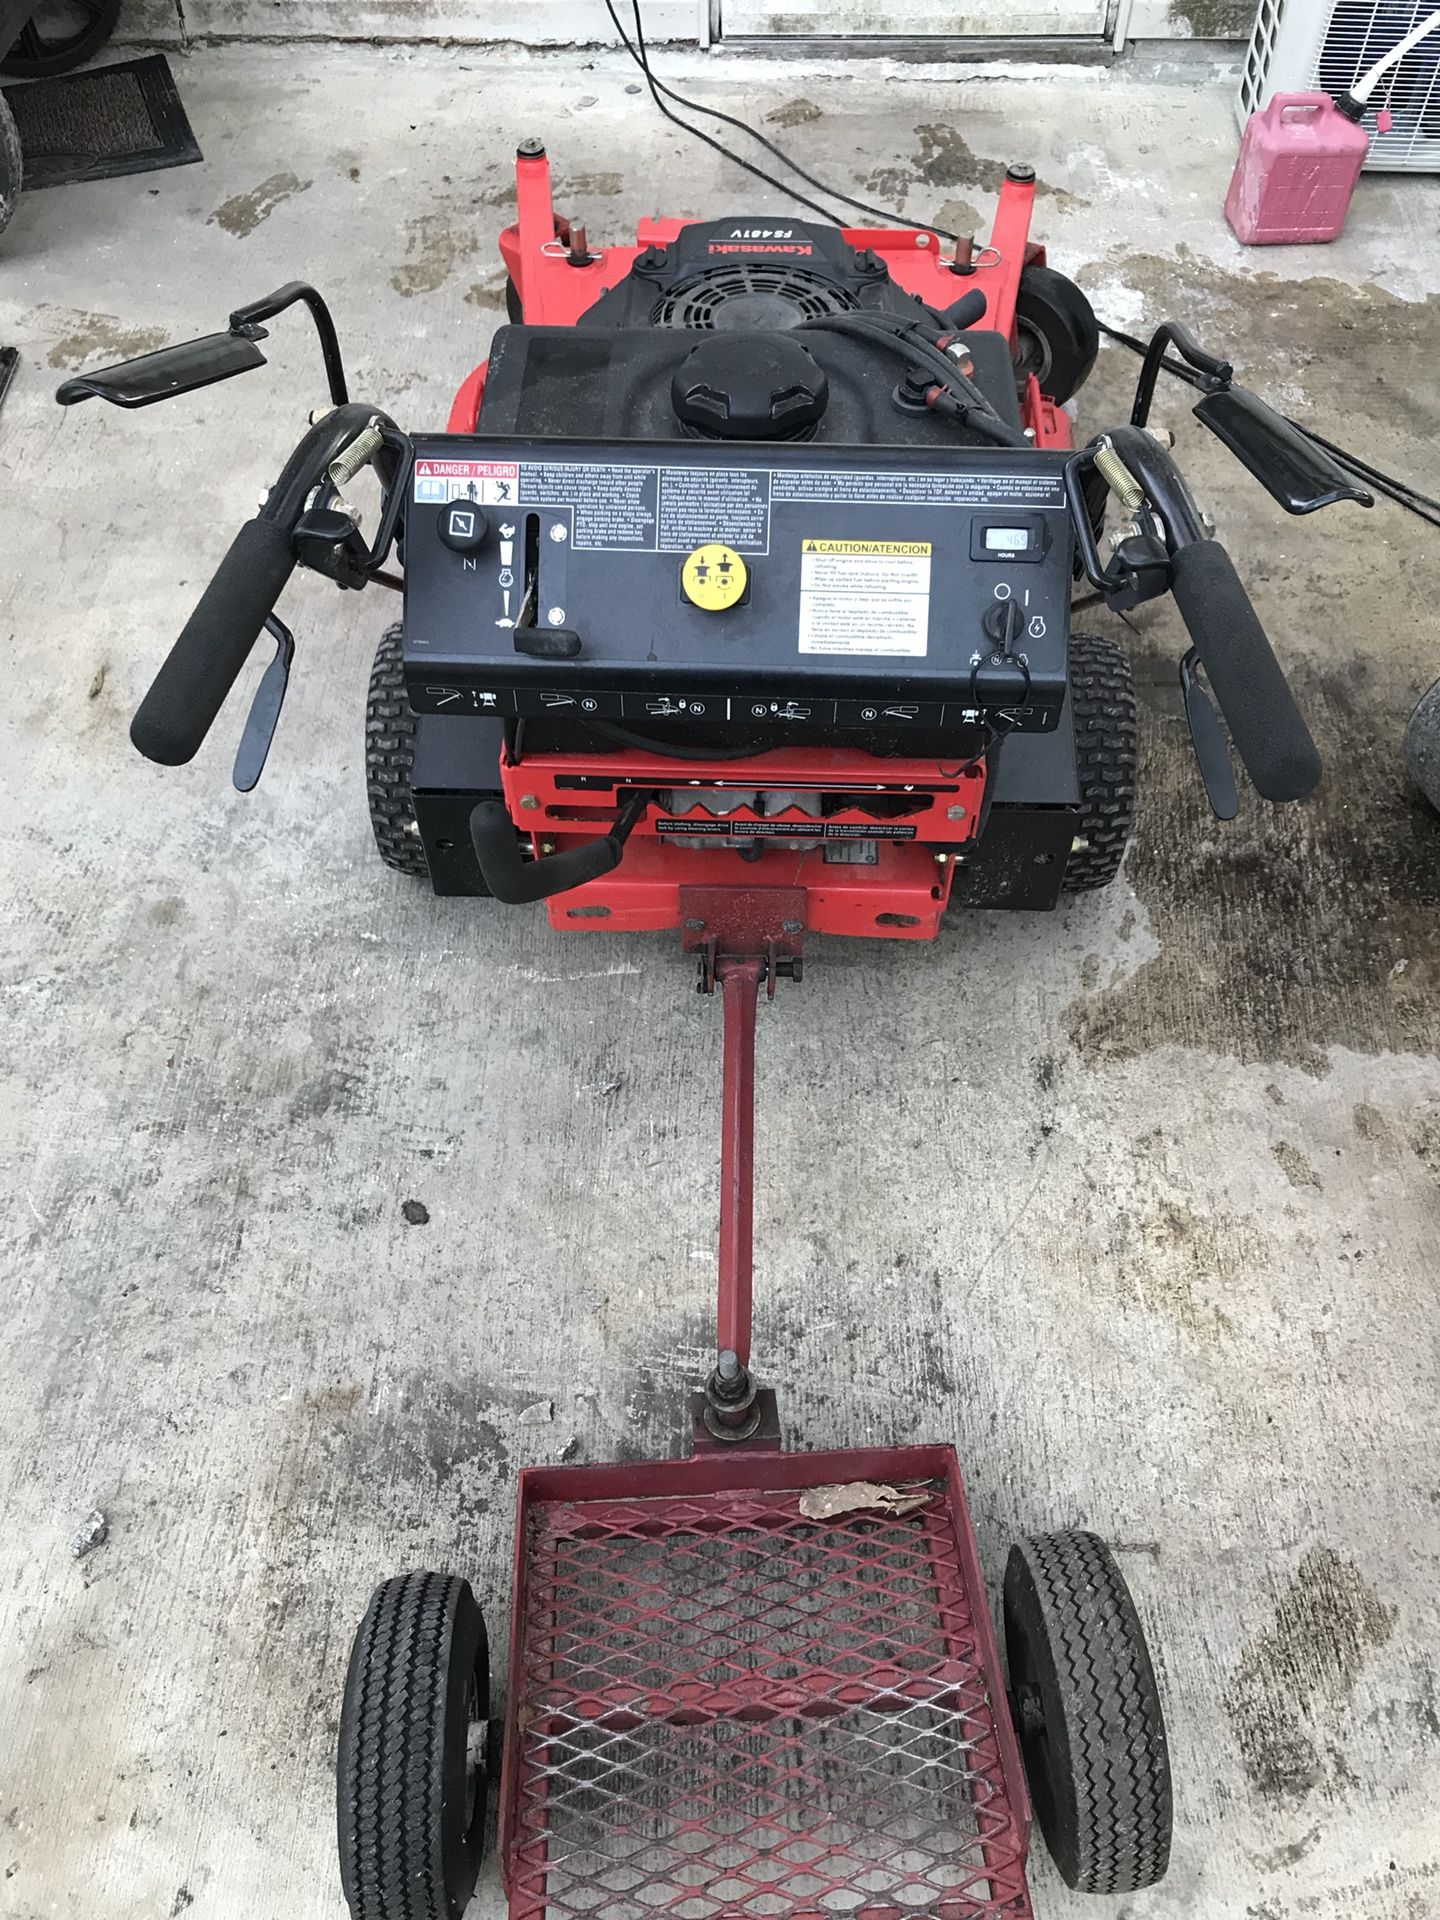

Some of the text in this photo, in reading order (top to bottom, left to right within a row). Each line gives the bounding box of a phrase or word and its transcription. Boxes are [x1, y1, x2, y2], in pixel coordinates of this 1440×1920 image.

[708, 244, 812, 256] Kawasaki
[433, 464, 469, 476] DANGER
[477, 466, 516, 477] PELIGRO
[820, 543, 928, 554] CAUTION/ATENCION
